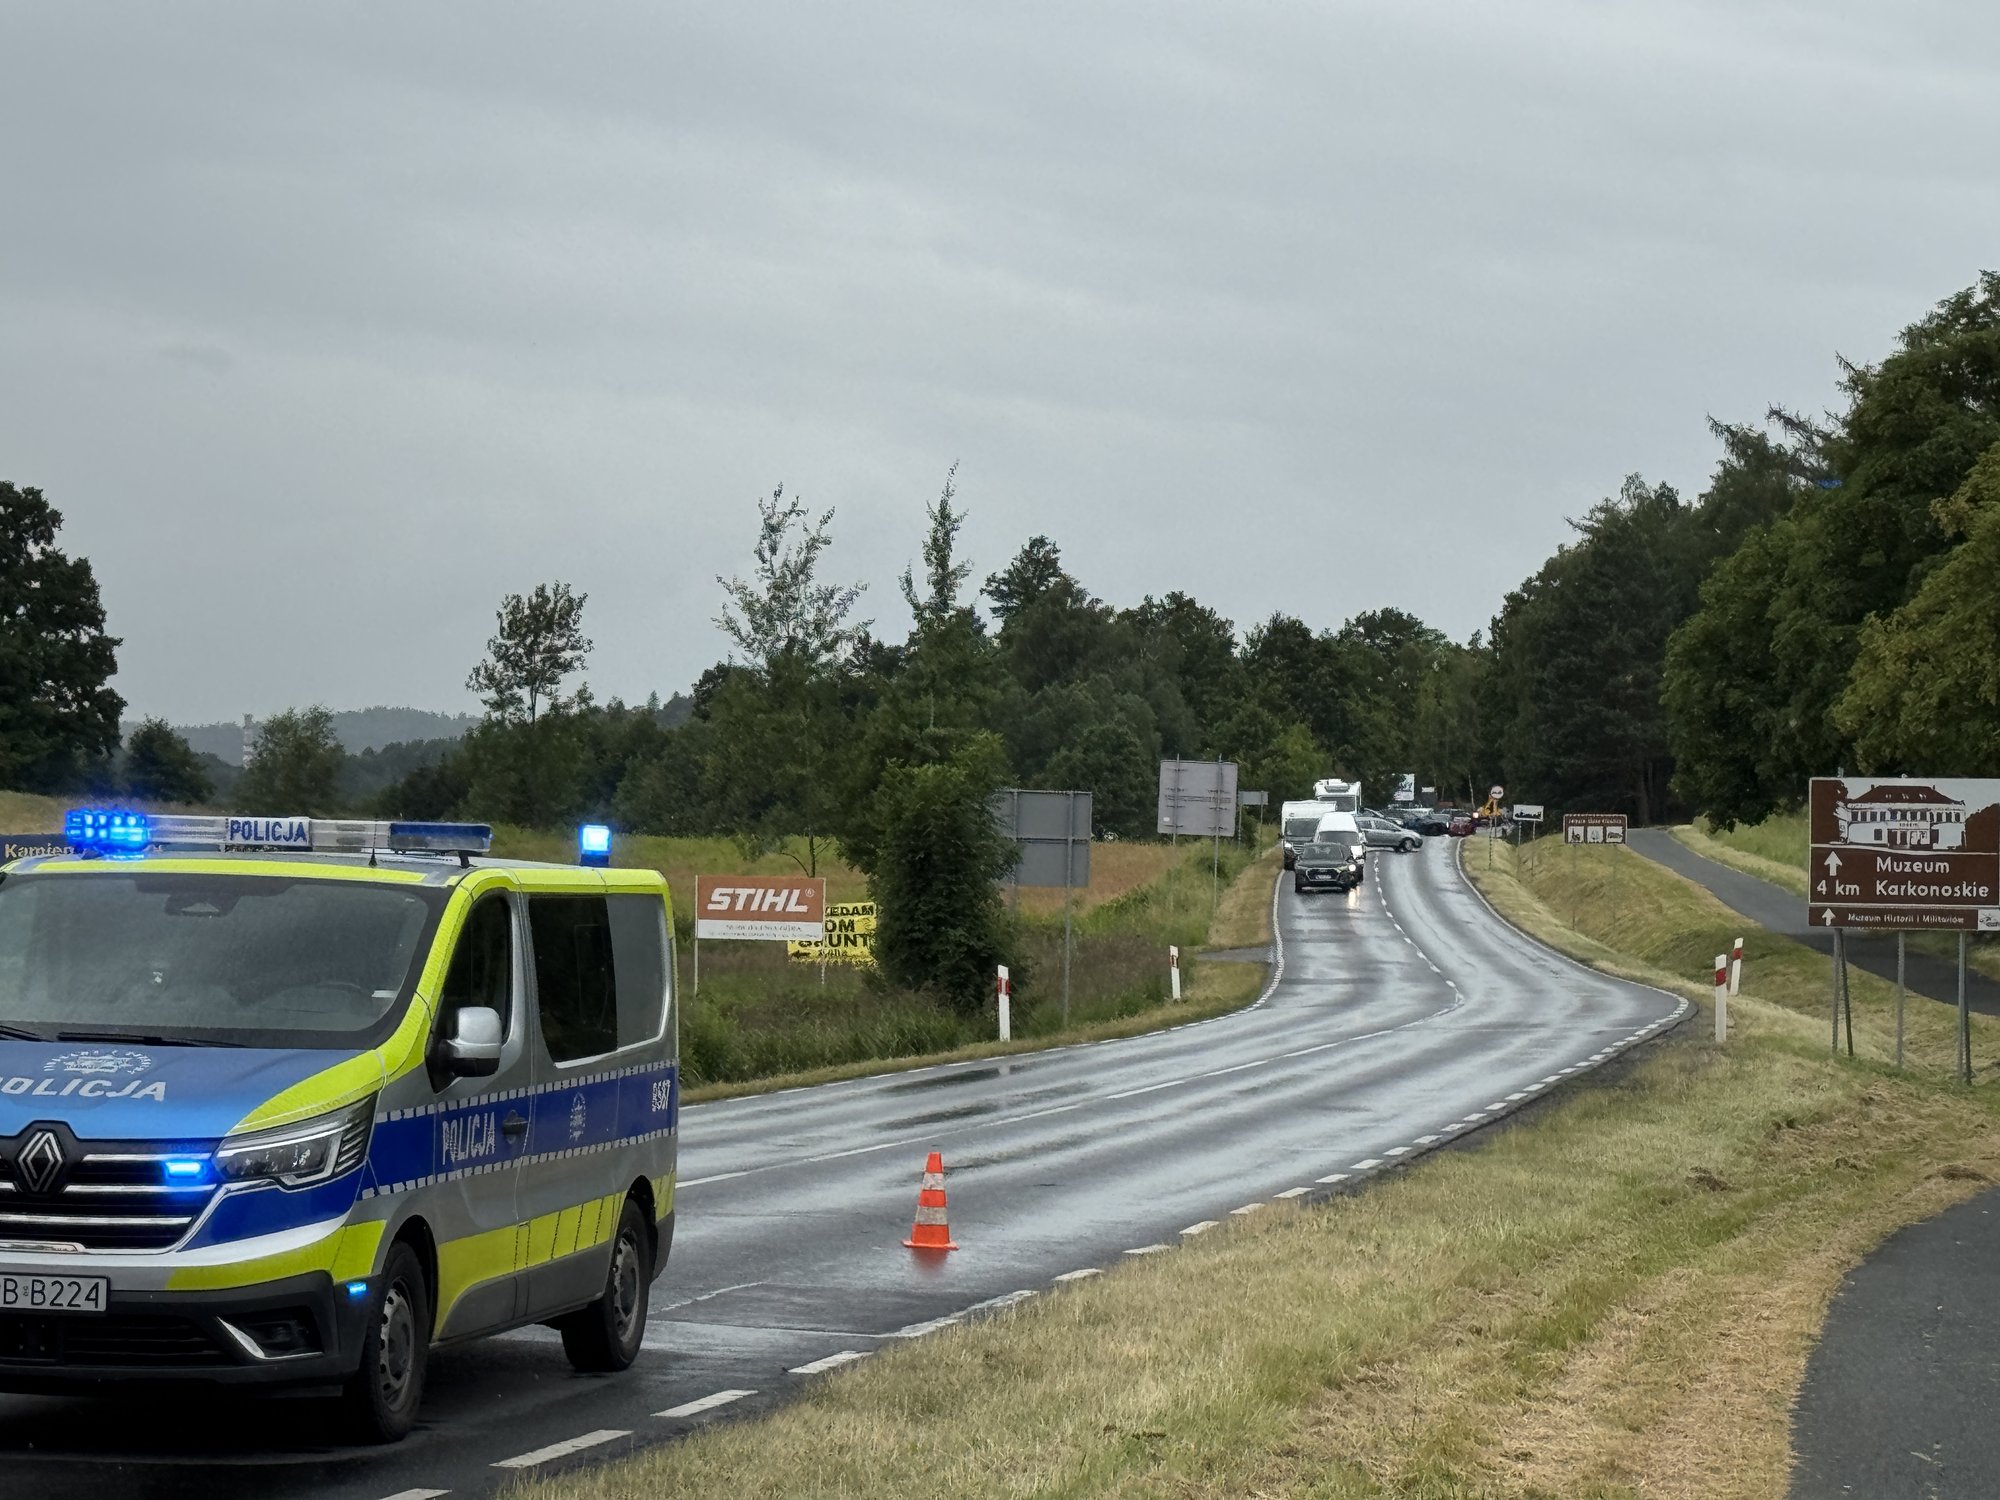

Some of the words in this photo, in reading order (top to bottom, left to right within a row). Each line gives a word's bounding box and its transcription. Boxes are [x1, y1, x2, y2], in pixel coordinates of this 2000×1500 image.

[230, 820, 307, 842] POLICJA
[1876, 856, 1950, 874] Muzeum
[707, 888, 808, 912] STIHL
[1817, 880, 1827, 895] 4
[1835, 880, 1860, 896] km
[1875, 880, 1989, 898] Karkonoskie
[0, 1077, 166, 1101] OLICJA
[442, 1112, 495, 1166] POLICJA
[0, 1278, 18, 1305] B
[31, 1279, 100, 1308] B224
